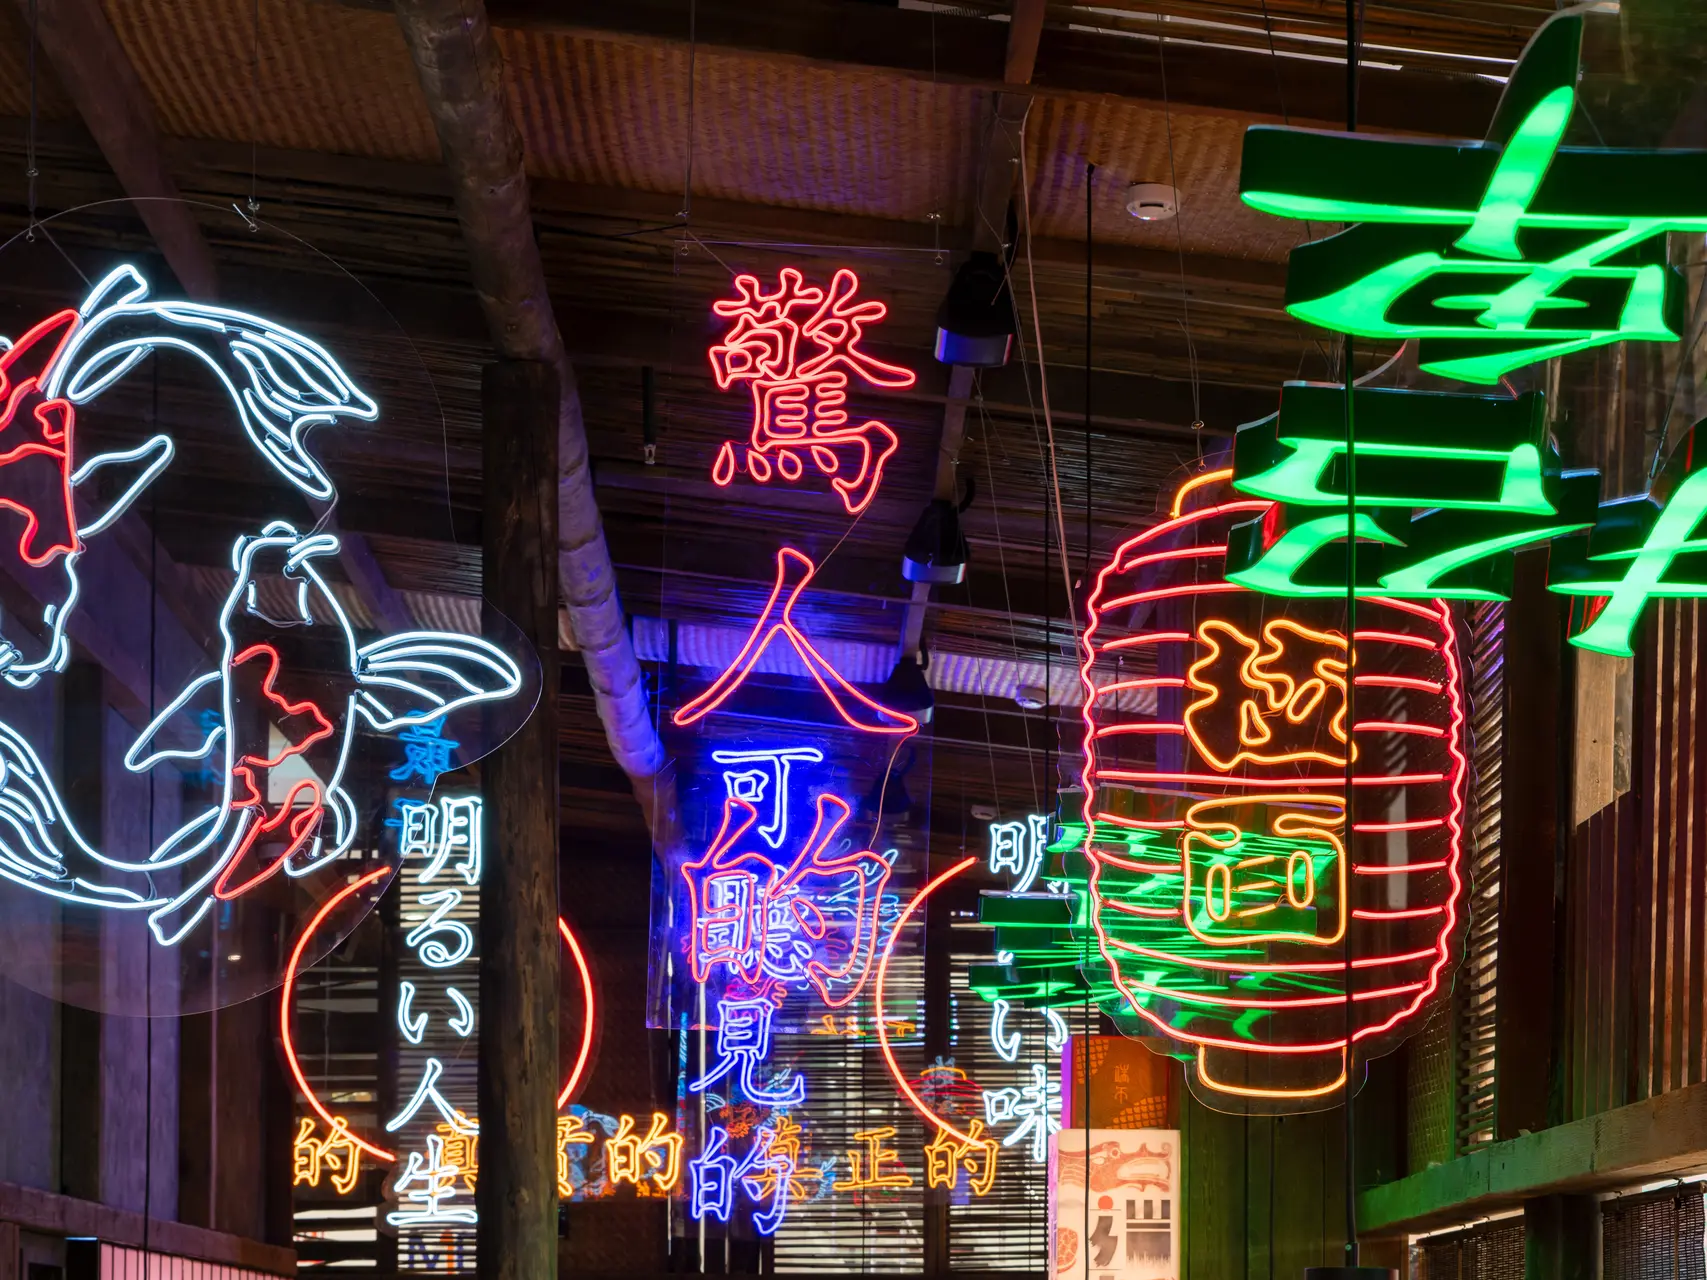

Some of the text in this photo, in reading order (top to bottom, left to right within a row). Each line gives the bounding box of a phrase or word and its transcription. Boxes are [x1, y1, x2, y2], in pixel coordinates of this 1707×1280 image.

[674, 267, 919, 1007] 驚人的
[387, 796, 483, 1226] 明るい人生
[982, 814, 1068, 1164] 明い味
